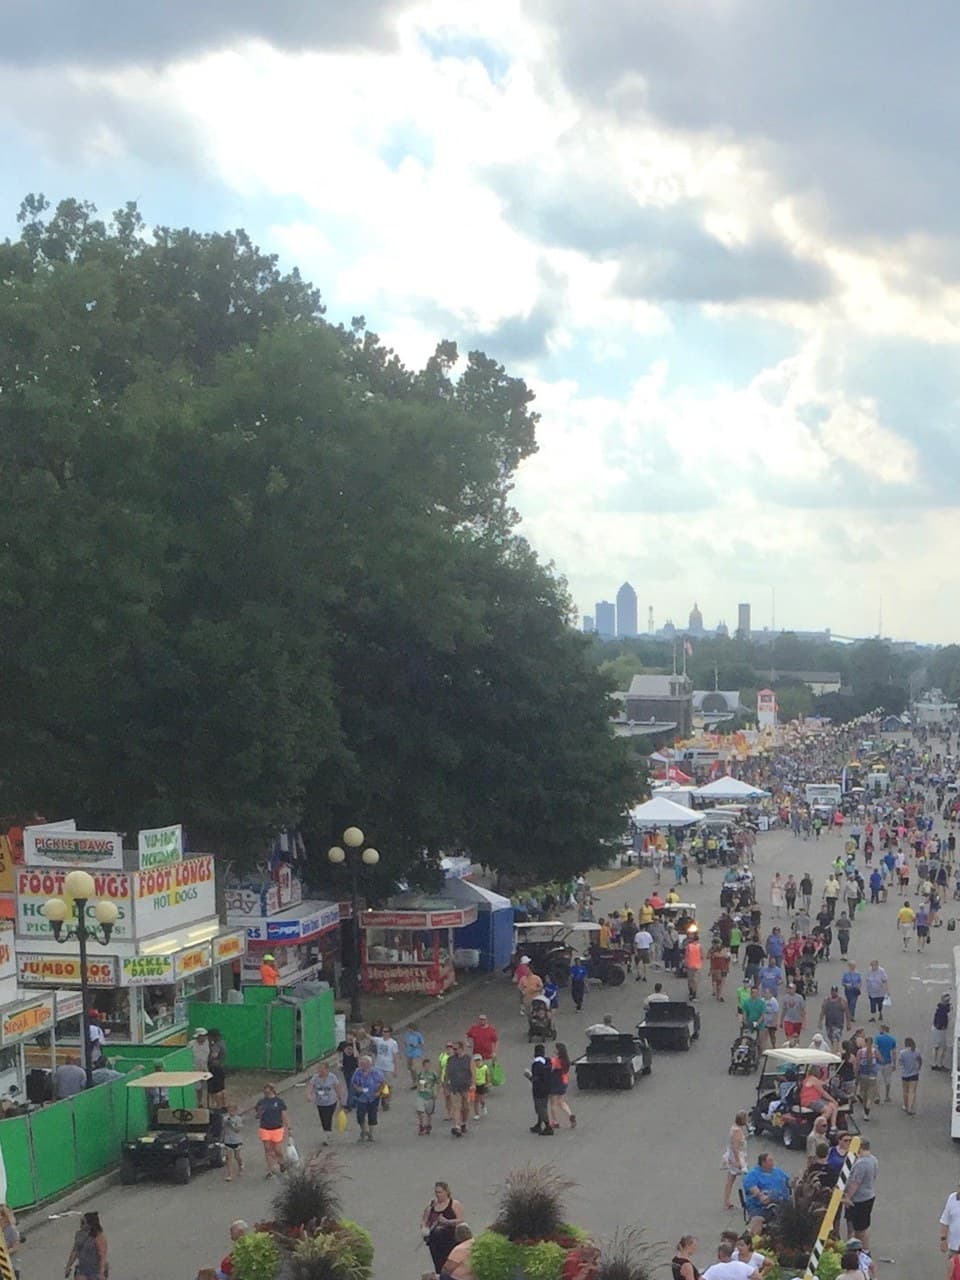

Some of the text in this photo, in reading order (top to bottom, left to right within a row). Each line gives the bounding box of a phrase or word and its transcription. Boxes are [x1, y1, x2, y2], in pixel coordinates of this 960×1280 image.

[34, 838, 114, 852] PICKLE DAWG
[19, 874, 128, 898] FOOT NGS
[139, 859, 211, 898] FOOT LONGS
[153, 887, 198, 910] HOT DOGS
[20, 962, 111, 977] JUMBO OG
[123, 957, 171, 968] PICKLE
[131, 966, 164, 977] DAWG
